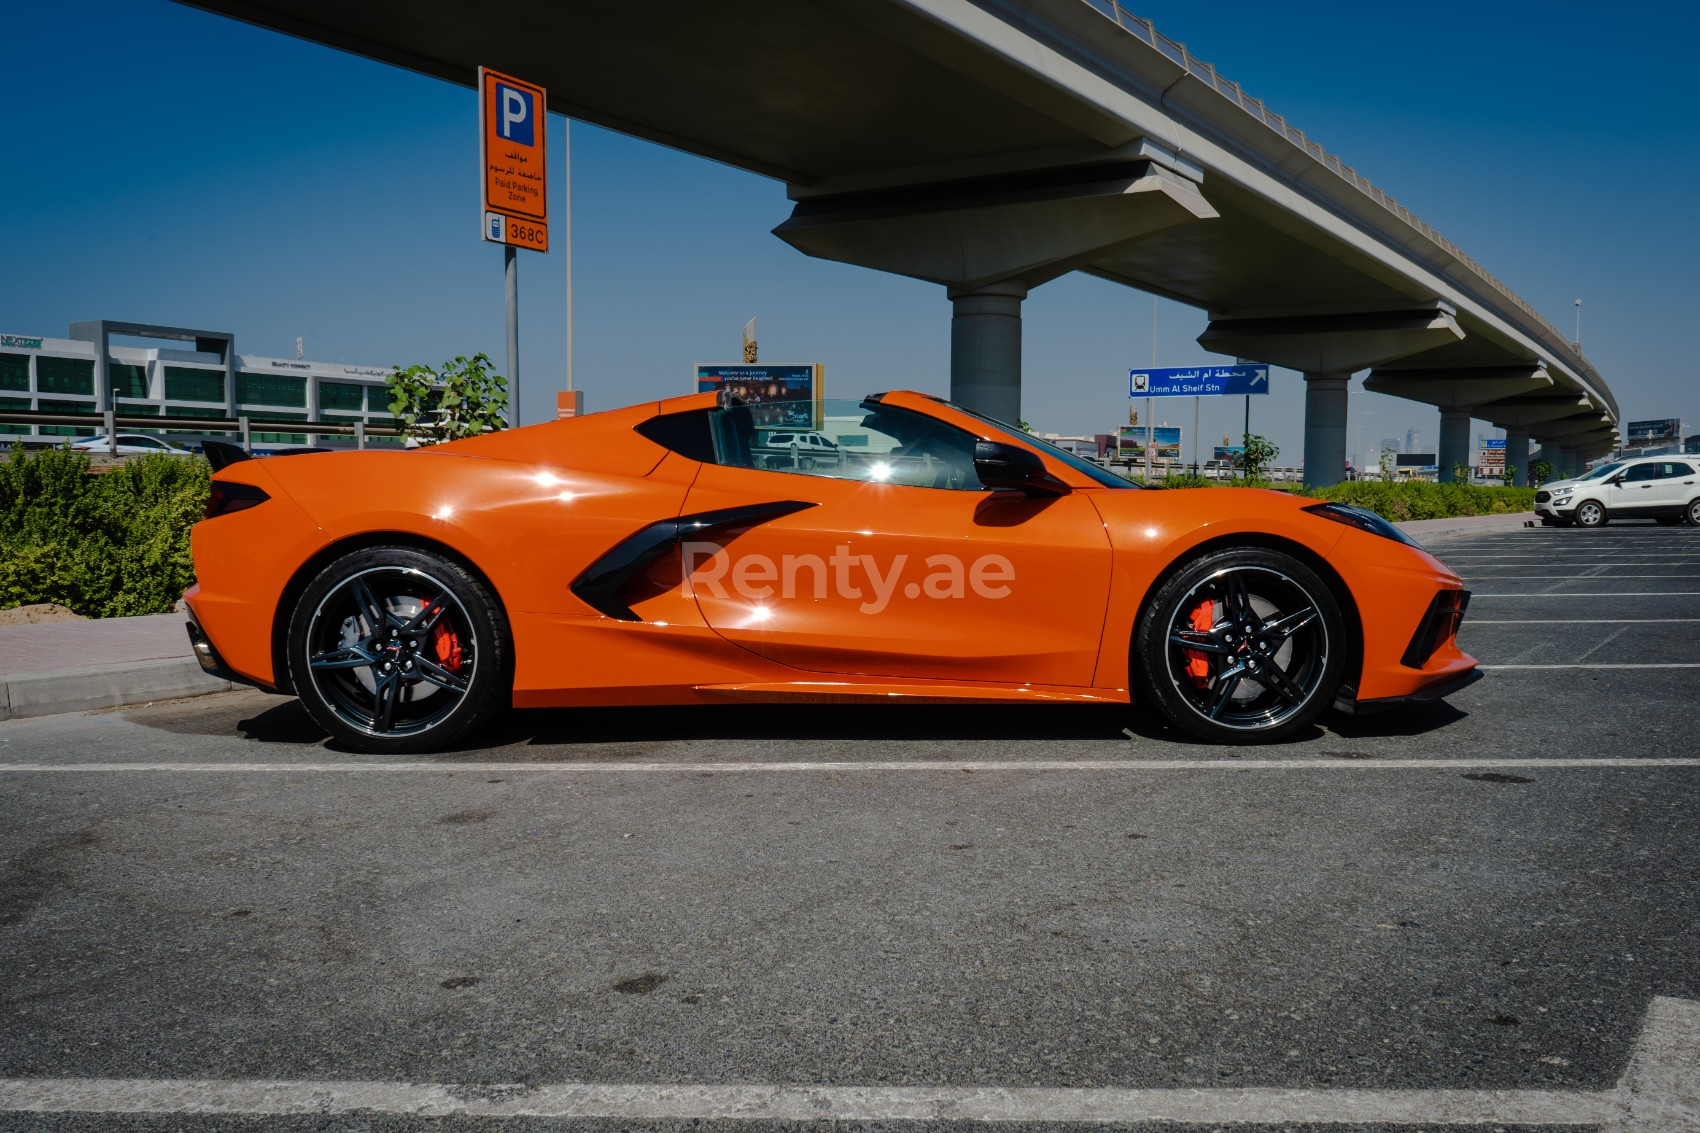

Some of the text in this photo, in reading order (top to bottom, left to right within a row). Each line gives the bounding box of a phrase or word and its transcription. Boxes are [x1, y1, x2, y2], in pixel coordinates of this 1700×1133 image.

[502, 87, 527, 138] P
[504, 151, 528, 163] مواقف
[489, 164, 515, 176] للرسوم
[495, 177, 538, 197] Paid Parking
[508, 191, 526, 203] Zone
[511, 223, 544, 244] 368C
[1169, 368, 1246, 382] محطة أم الشيف
[1149, 384, 1220, 393] Umm Al Sheif Stn
